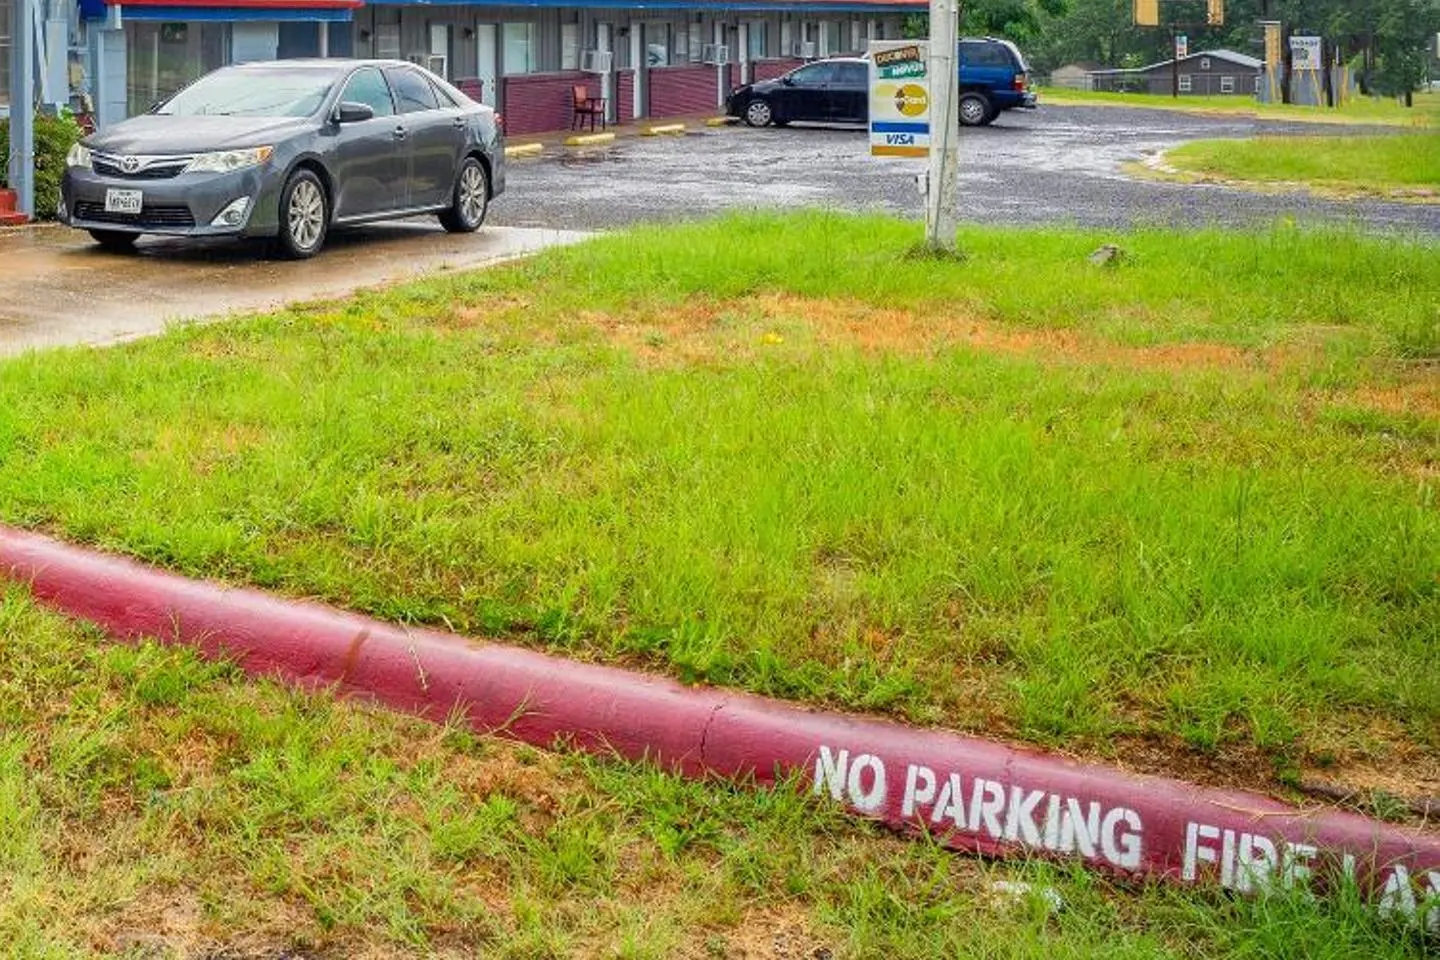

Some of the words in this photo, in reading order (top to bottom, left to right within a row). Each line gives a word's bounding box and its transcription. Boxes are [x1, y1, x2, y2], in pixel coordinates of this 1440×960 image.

[886, 134, 915, 145] VISA
[813, 745, 886, 810] NO
[901, 764, 1143, 869] PARKING
